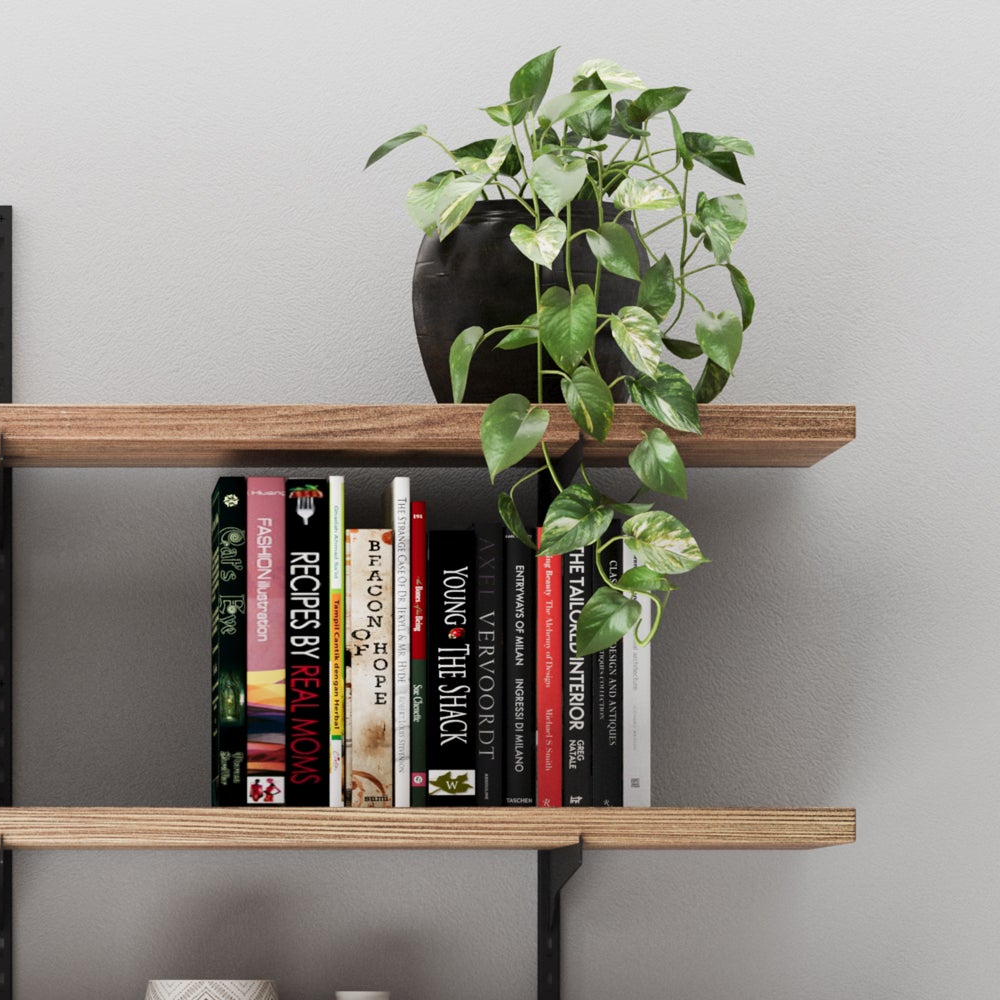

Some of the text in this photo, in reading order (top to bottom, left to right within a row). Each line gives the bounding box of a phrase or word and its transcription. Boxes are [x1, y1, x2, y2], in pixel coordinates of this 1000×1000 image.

[569, 546, 585, 574] THE
[367, 540, 383, 628] BEACON
[543, 570, 553, 596] Beauty
[219, 594, 246, 635] Eye
[332, 600, 340, 630] Tampil
[545, 600, 553, 615] The
[478, 537, 496, 760] AXEL VERVOORDT
[544, 617, 553, 649] Alchemy
[290, 552, 322, 785] RECIPES BY REAL MOMS
[438, 566, 471, 747] YOUNG THE SHACK
[515, 565, 525, 773] ENTRYWAYS OF MILAN INGRESSI DI MILANO
[545, 651, 553, 660] of
[332, 663, 340, 697] dengan
[373, 643, 388, 705] HOPE
[544, 661, 553, 688] Design
[569, 657, 585, 731] INTERIOR
[545, 708, 553, 738] Michael
[545, 747, 553, 771] Smith
[569, 739, 577, 770] NATALE
[576, 739, 585, 762] GREG
